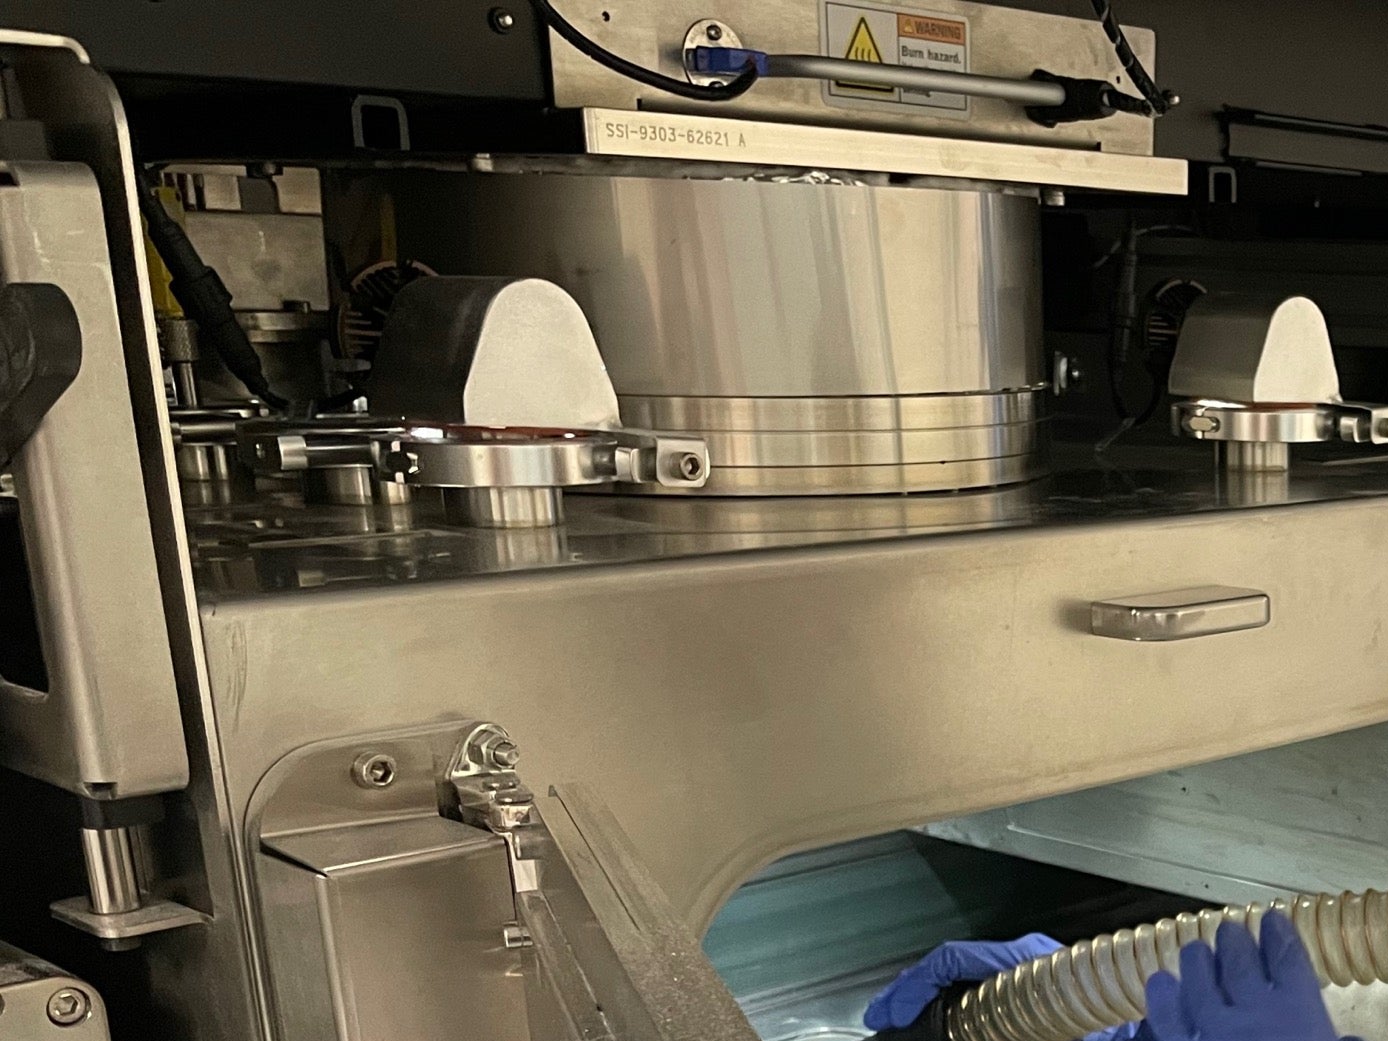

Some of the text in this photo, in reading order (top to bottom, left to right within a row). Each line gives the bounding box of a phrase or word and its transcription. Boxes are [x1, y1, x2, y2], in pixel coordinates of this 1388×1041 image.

[914, 20, 962, 40] WARNING
[901, 45, 962, 64] Burn hazard.
[605, 122, 746, 148] SSI-9303-62621 A
